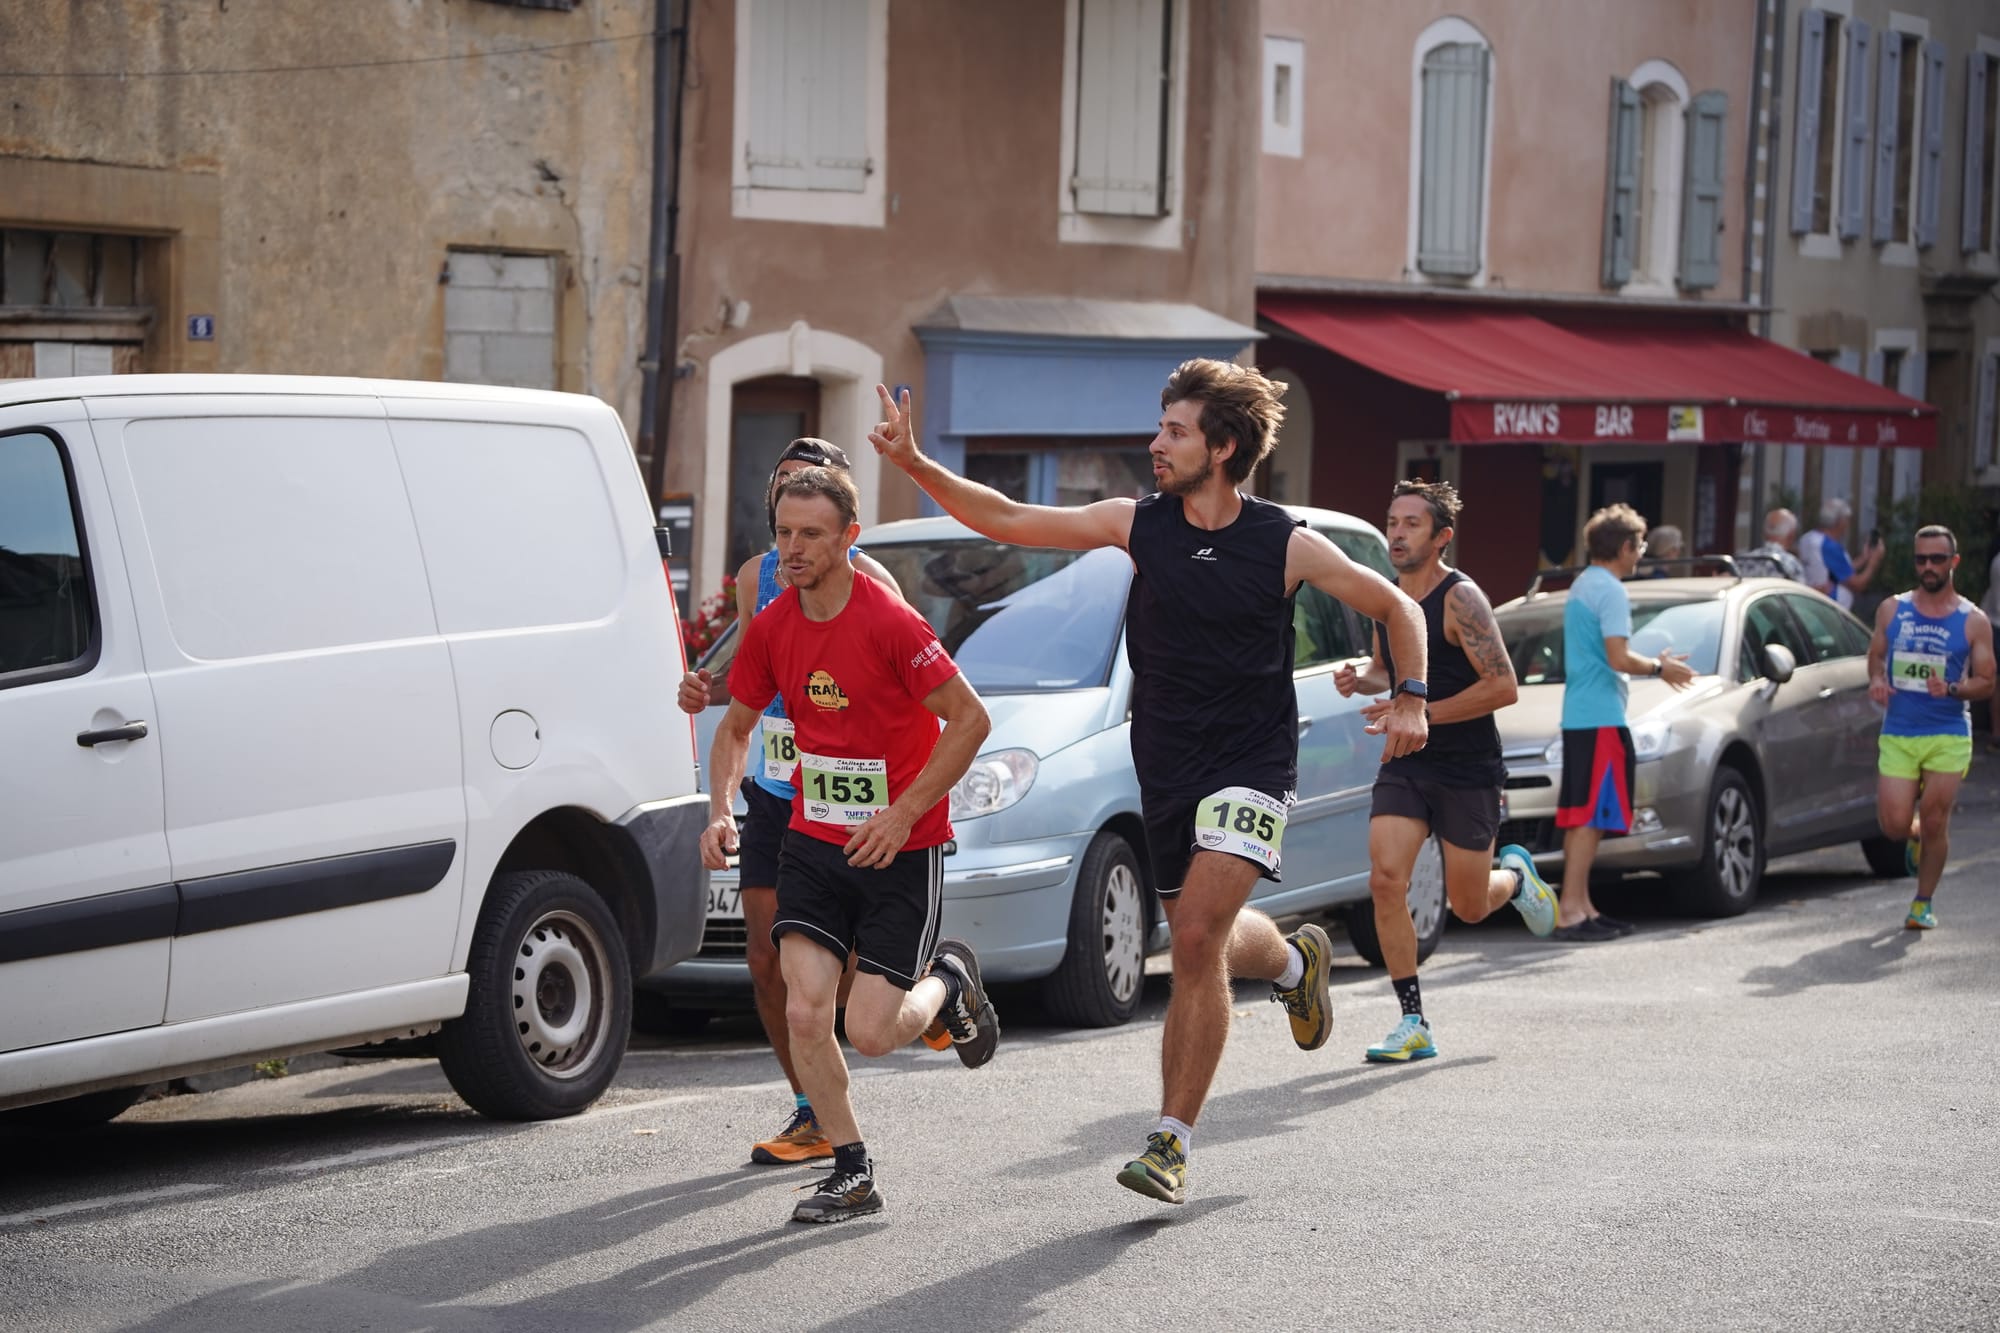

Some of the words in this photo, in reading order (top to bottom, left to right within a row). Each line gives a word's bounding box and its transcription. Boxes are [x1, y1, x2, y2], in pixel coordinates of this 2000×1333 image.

[1494, 403, 1560, 436] RYAN'S
[1594, 405, 1634, 437] BAR
[1905, 663, 1930, 679] 46
[813, 773, 875, 804] 153
[844, 810, 872, 818] TUFF'S
[1213, 801, 1276, 842] 185
